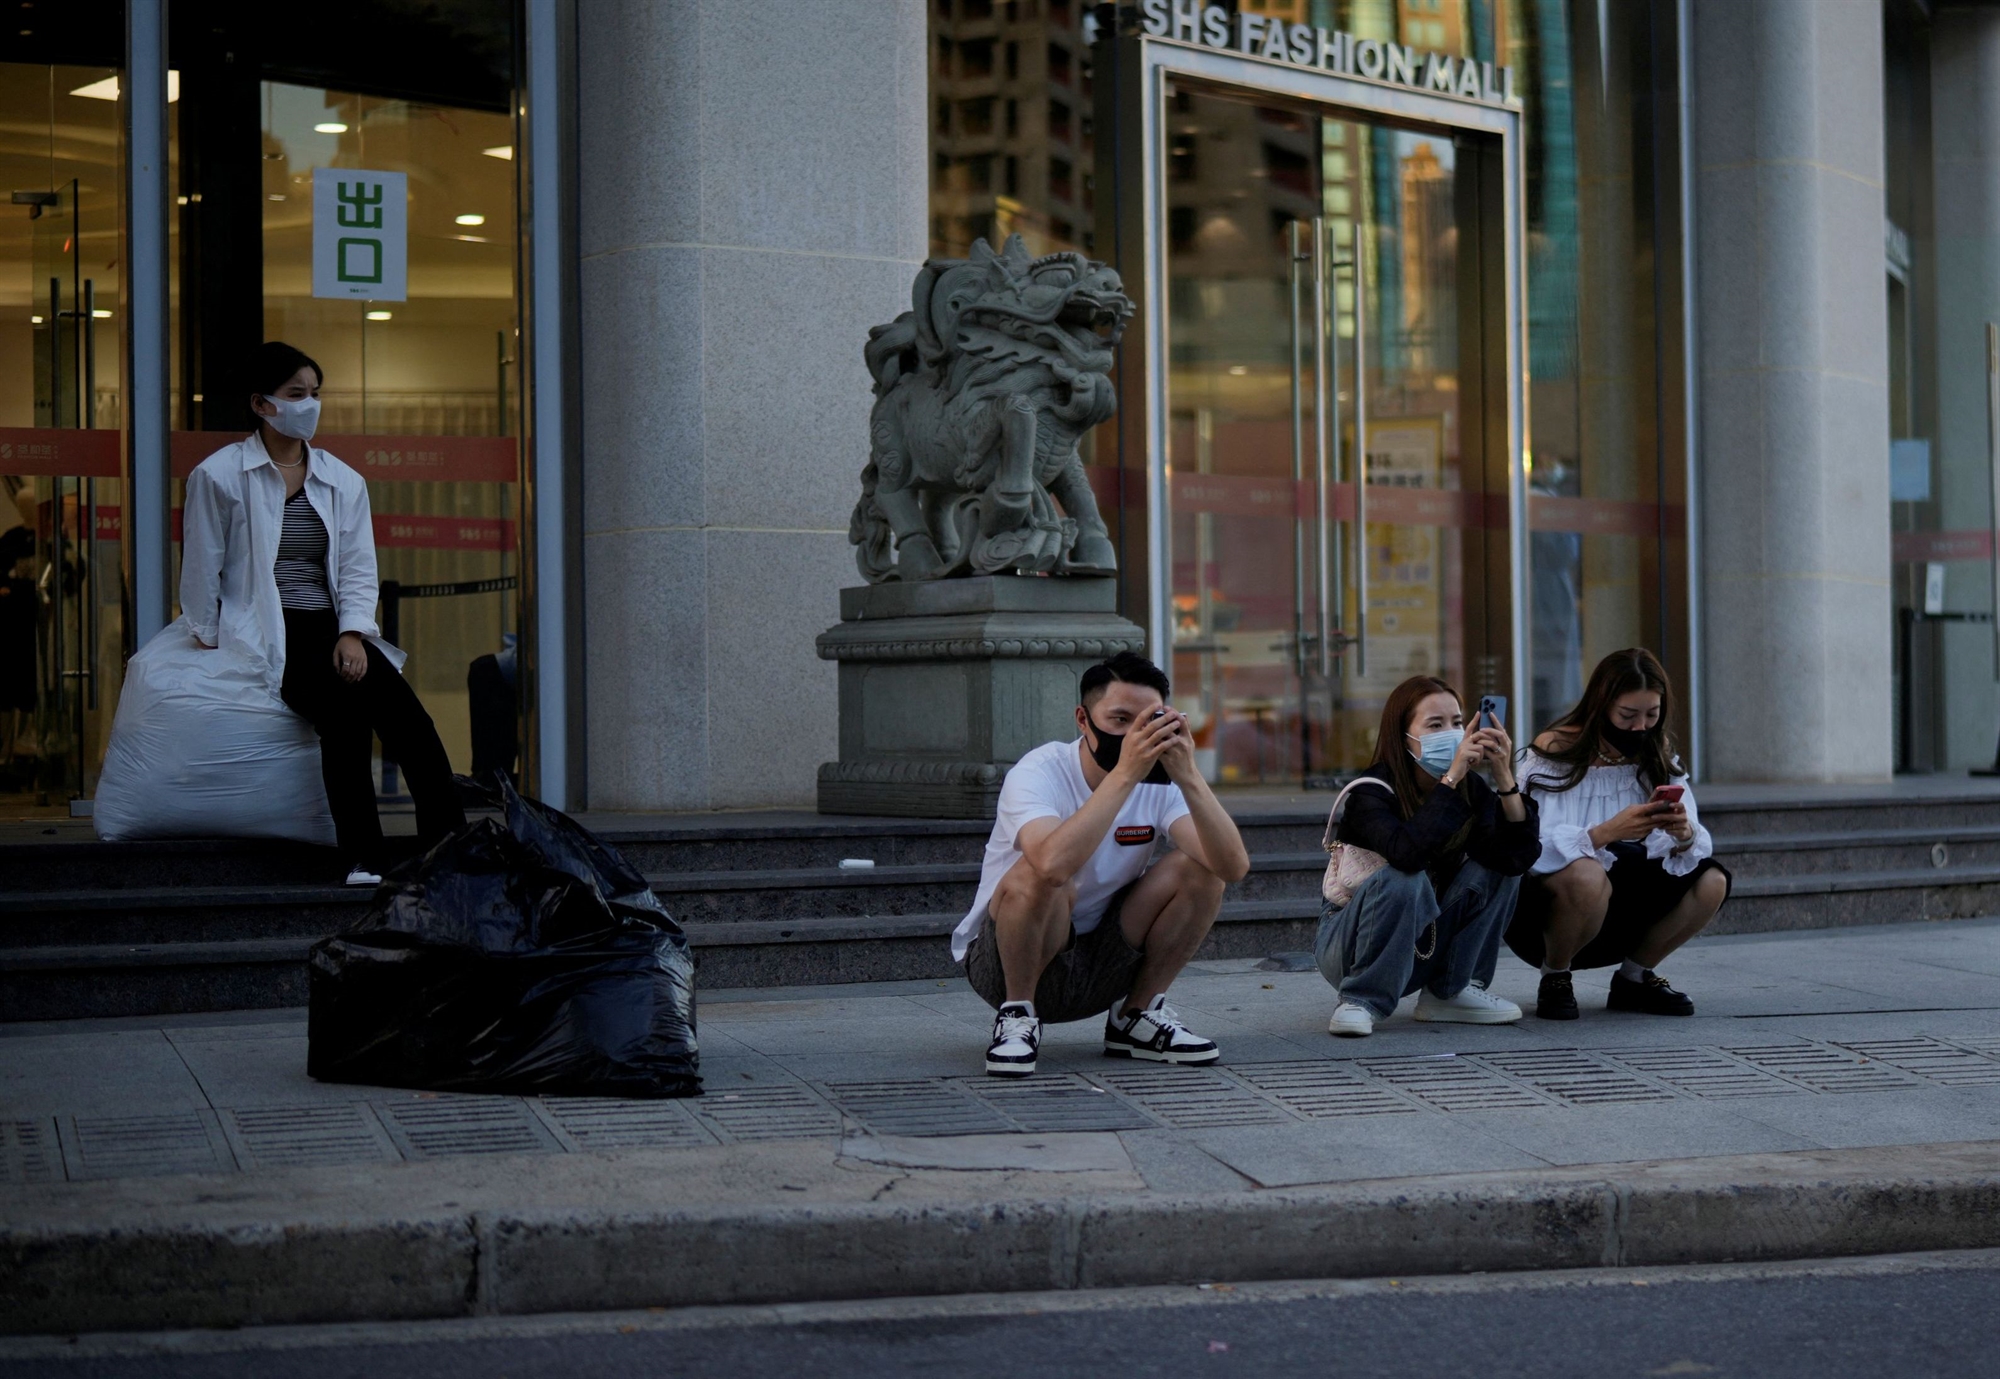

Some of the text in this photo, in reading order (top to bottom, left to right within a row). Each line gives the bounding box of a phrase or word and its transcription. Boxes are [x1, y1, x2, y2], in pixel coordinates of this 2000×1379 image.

[1143, 0, 1523, 107] SHS FASHION MALL
[337, 182, 383, 283] 出口
